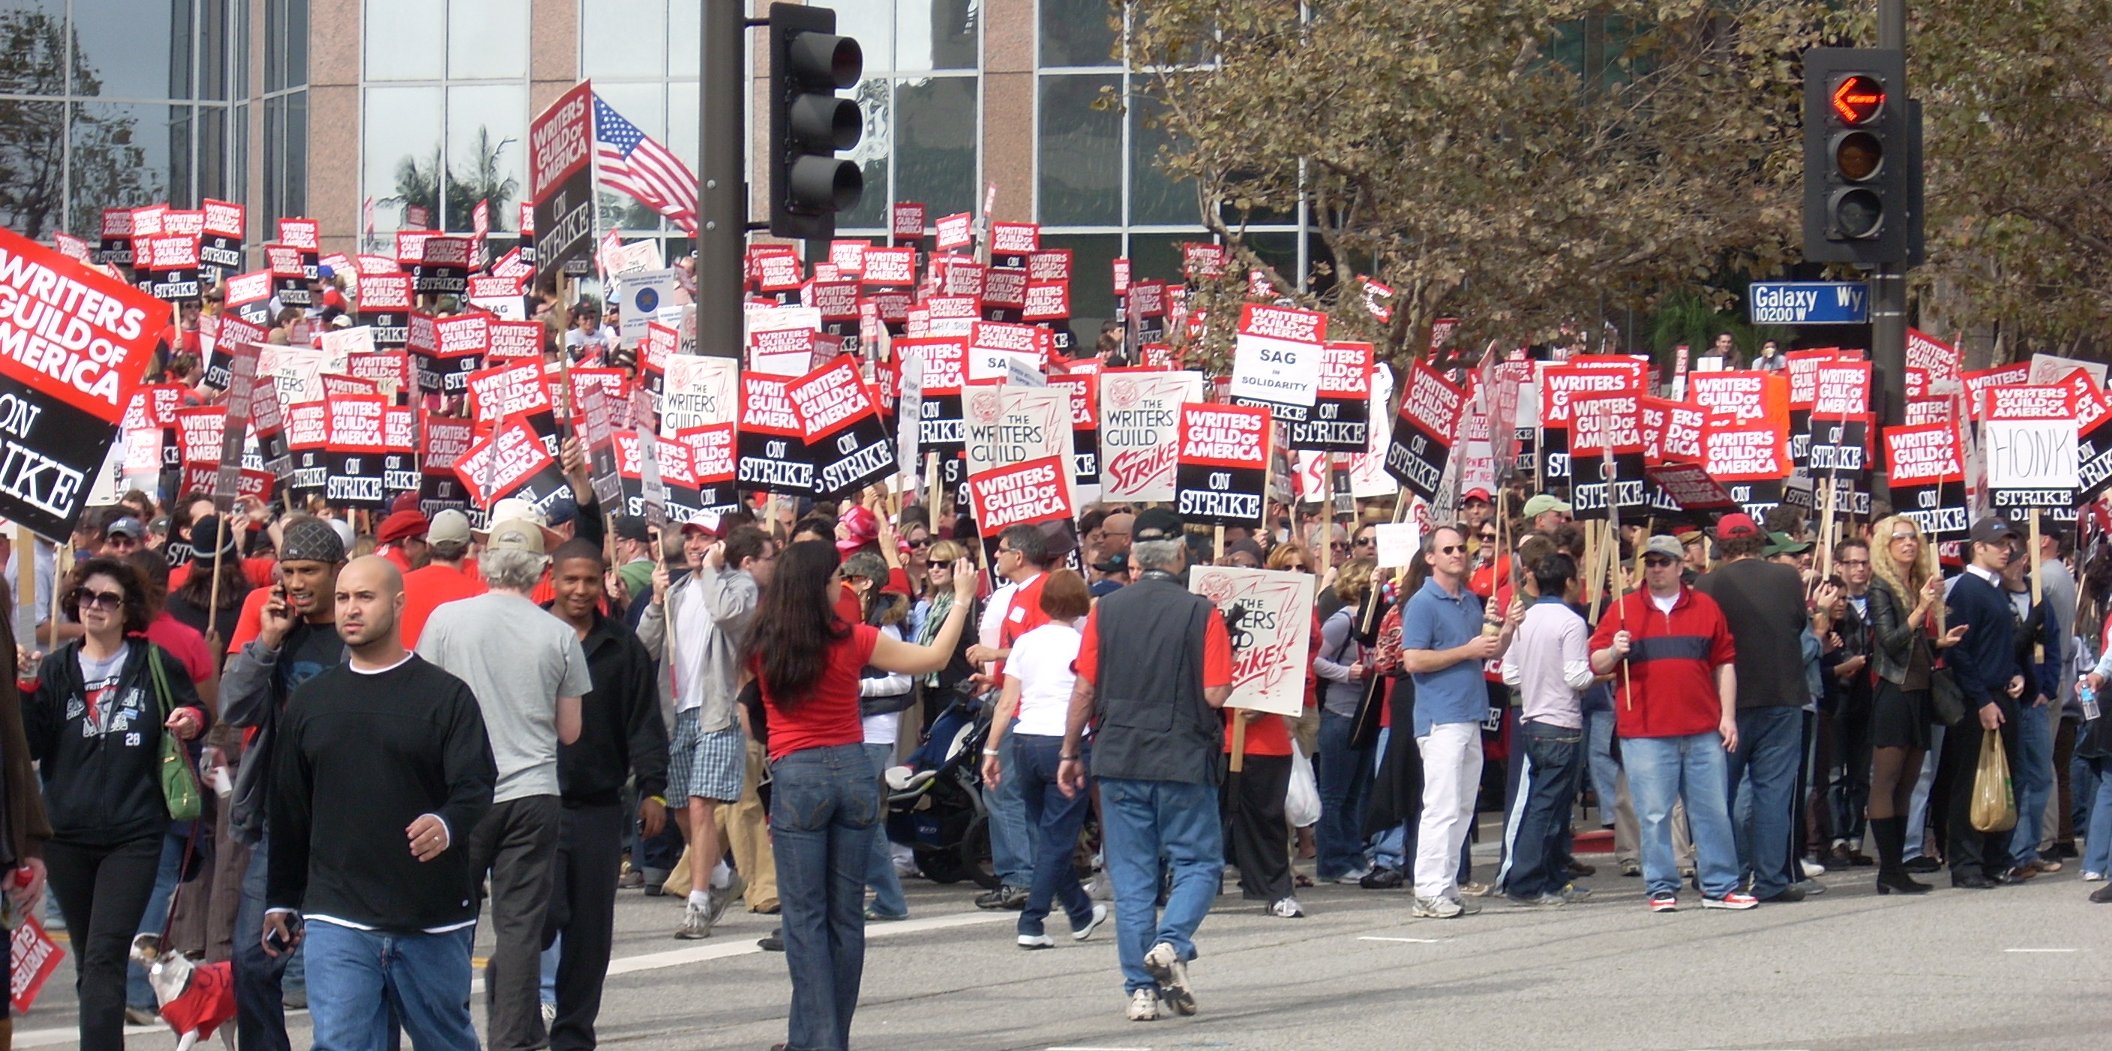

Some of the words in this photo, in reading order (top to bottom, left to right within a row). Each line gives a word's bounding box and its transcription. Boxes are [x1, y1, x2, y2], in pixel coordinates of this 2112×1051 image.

[533, 95, 585, 151] WRITERS
[537, 128, 571, 171] GUILD
[571, 121, 584, 143] OF
[535, 136, 587, 195] AMERICA
[205, 204, 240, 213] WRITERS
[553, 190, 567, 221] ON
[203, 224, 241, 235] AMERICA
[281, 223, 315, 232] WRITERS
[994, 226, 1034, 235] WRITERS
[152, 237, 193, 248] WRITERS
[427, 239, 468, 249] WRITERS
[537, 201, 590, 276] STRIKE
[993, 243, 1036, 251] AMERICA
[153, 255, 196, 266] AMERICA
[200, 247, 239, 266] STRIKE
[760, 256, 794, 267] WRITERS
[864, 252, 910, 262] WRITERS
[1007, 256, 1020, 267] ON
[1030, 254, 1067, 263] WRITERS
[866, 262, 897, 271] GUILD
[168, 271, 181, 282] ON
[360, 277, 407, 288] WRITERS
[763, 275, 799, 286] AMERICA
[863, 271, 911, 281] AMERICA
[987, 274, 1026, 285] WRITERS
[154, 282, 198, 298] STRIKE
[420, 278, 465, 291] STRIKE
[815, 285, 857, 296] WRITERS
[986, 284, 1013, 293] GUILD
[0, 249, 146, 340] WRITERS
[363, 288, 394, 297] GUILD
[983, 293, 1024, 304] AMERICA
[1755, 286, 1818, 312] Galaxy
[1836, 286, 1863, 312] Wy
[360, 297, 409, 307] AMERICA
[817, 296, 846, 306] GUILD
[377, 314, 392, 326] ON
[991, 310, 1005, 321] ON
[1251, 307, 1318, 325] WRITERS
[1756, 307, 1794, 321] 10200
[1795, 307, 1807, 321] W
[437, 318, 487, 334] WRITERS
[489, 325, 538, 337] WRITERS
[829, 324, 841, 335] ON
[978, 325, 1035, 336] WRITERS
[1250, 316, 1293, 330] GUILD
[1298, 323, 1315, 332] OF
[441, 331, 474, 344] GUILD
[757, 330, 810, 340] WRITERS
[1246, 325, 1317, 342] AMERICA
[491, 336, 525, 347] GUILD
[751, 343, 812, 354] AMERICA
[975, 339, 1035, 351] AMERICA
[1908, 334, 1957, 364] WRITERS
[89, 338, 127, 367] OF
[488, 346, 539, 356] AMERICA
[897, 343, 962, 360] WRITERS
[1260, 349, 1297, 365] SAG
[0, 322, 119, 405] MERICA
[351, 356, 402, 367] WRITERS
[460, 358, 475, 370] ON
[946, 361, 961, 373] OF
[988, 357, 1007, 369] SA
[1906, 349, 1938, 370] GUILD
[1348, 367, 1363, 378] OF
[1819, 369, 1865, 384] WRITERS
[1967, 368, 2027, 391] WRITERS
[325, 378, 373, 395] WRITERS
[524, 381, 540, 394] OF
[692, 384, 707, 393] THE
[790, 364, 854, 405] WRITERS
[1241, 376, 1308, 392] SOLIDARITY
[1414, 367, 1460, 409] WRITERS
[1549, 375, 1625, 391] WRITERS
[1695, 378, 1761, 393] WRITERS
[1697, 392, 1743, 406] GUILD
[1743, 394, 1760, 405] OF
[1850, 387, 1862, 398] OF
[1994, 388, 2068, 398] WRITERS
[667, 392, 716, 413] WRITERS
[800, 388, 844, 418] GUILD
[844, 383, 859, 398] OF
[1142, 400, 1163, 409] THE
[1411, 384, 1443, 416] GUILD
[1442, 408, 1453, 422] OF
[1997, 399, 2046, 408] GUILD
[291, 406, 325, 419] WRITERS
[331, 401, 382, 416] WRITERS
[805, 394, 870, 436] AMERICA
[921, 401, 940, 418] ON
[1319, 403, 1339, 419] ON
[1993, 407, 2070, 417] AMERICA
[293, 420, 316, 432] GUILD
[333, 417, 366, 431] GUILD
[366, 420, 380, 431] OF
[1008, 415, 1030, 425] THE
[1107, 410, 1174, 428] WRITERS
[1185, 410, 1262, 431] WRITERS
[1403, 399, 1451, 439] AMERICA
[1622, 417, 1636, 429] OF
[292, 430, 327, 444] AMERICA
[329, 431, 383, 445] AMERICA
[429, 424, 470, 440] WRITERS
[1106, 429, 1158, 447] GUILD
[1188, 428, 1240, 443] GUILD
[1241, 433, 1259, 446] OF
[1293, 420, 1366, 444] STRIKE
[1681, 429, 1700, 442] OF
[1707, 431, 1774, 447] WRITERS
[429, 440, 458, 453] GUILD
[837, 432, 859, 455] ON
[1411, 434, 1428, 456] ON
[1889, 430, 1954, 450] WRITERS
[766, 440, 786, 459] ON
[1183, 443, 1263, 461] AMERICA
[1708, 447, 1753, 461] GUILD
[1754, 448, 1773, 459] OF
[1894, 447, 1938, 465] GUILD
[1990, 428, 2073, 482] HONK
[302, 453, 314, 467] ON
[345, 458, 361, 475] ON
[385, 456, 401, 470] ON
[823, 440, 893, 492] STRIKE
[1387, 441, 1440, 493] STRIKE
[1706, 459, 1778, 475] AMERICA
[738, 457, 814, 488] STRIKE
[1893, 459, 1960, 480] AMERICA
[0, 439, 84, 519] IKE
[977, 465, 1056, 497] WRITERS
[1209, 472, 1231, 490] ON
[327, 476, 383, 500] STRIKE
[1731, 486, 1750, 502] ON
[700, 488, 716, 505] ON
[984, 485, 1039, 511] GUILD
[1039, 485, 1057, 498] OF
[1179, 489, 1261, 519] STRIKE
[1918, 491, 1937, 508] ON
[1995, 490, 2073, 506] STRIKE
[985, 499, 1065, 528] AMERICA
[1239, 598, 1264, 609] THE
[125, 732, 140, 746] 28
